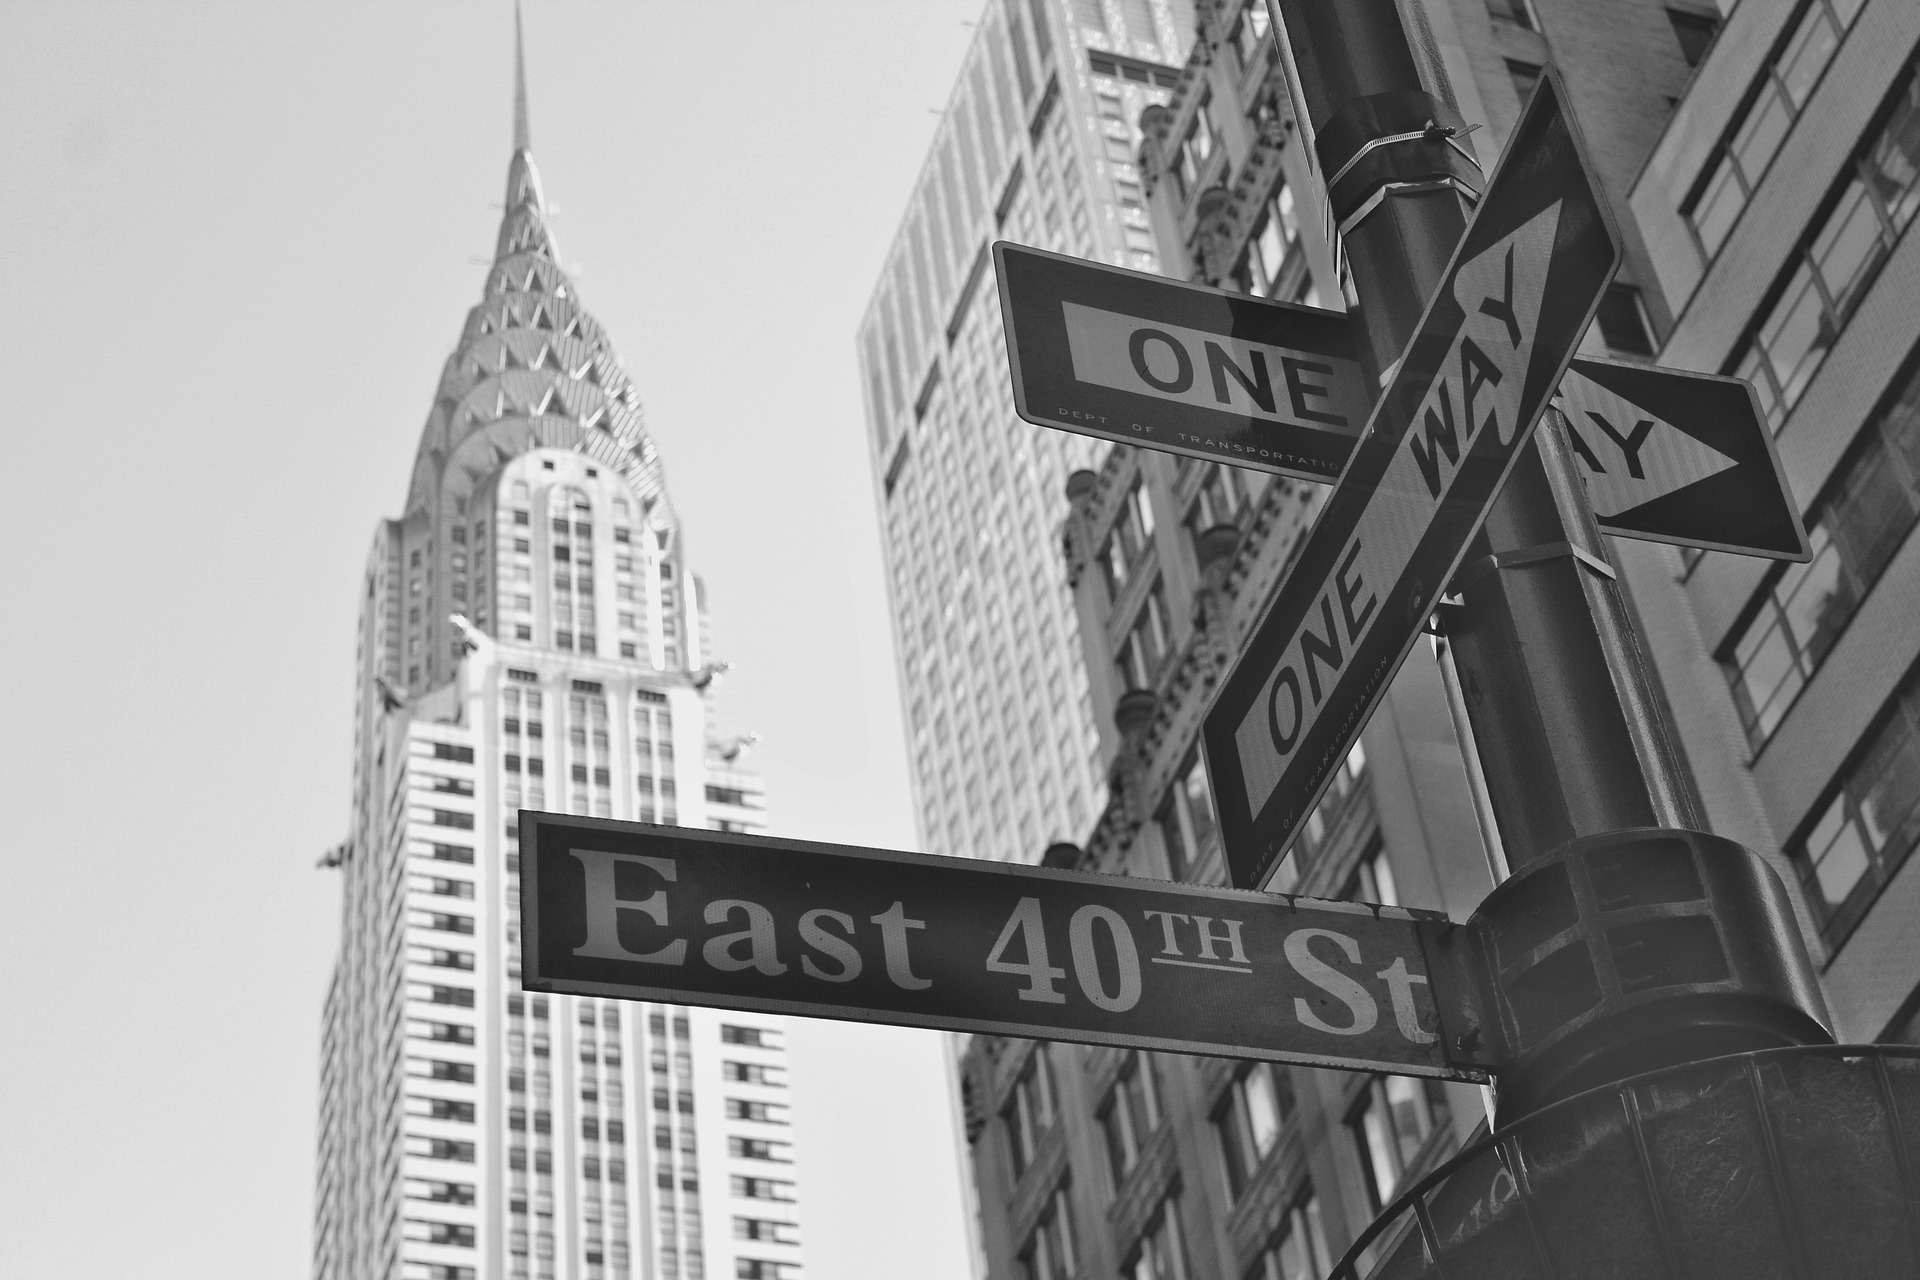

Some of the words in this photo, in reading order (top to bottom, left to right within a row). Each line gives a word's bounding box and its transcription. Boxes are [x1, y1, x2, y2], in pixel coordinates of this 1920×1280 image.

[1058, 407, 1107, 424] DEPT
[1131, 423, 1155, 434] OF
[1178, 432, 1340, 471] TRANSPORTATIO
[1129, 328, 1349, 428] ONE
[1561, 410, 1655, 480] AY
[1268, 537, 1378, 756] ONE
[1409, 241, 1522, 502] WAY
[1250, 843, 1273, 882] DEPT
[1283, 809, 1295, 829] OF
[1304, 656, 1387, 794] TRANSPORTATION
[569, 848, 933, 991] East
[985, 896, 1252, 1013] 40TH
[1283, 927, 1441, 1045] St
